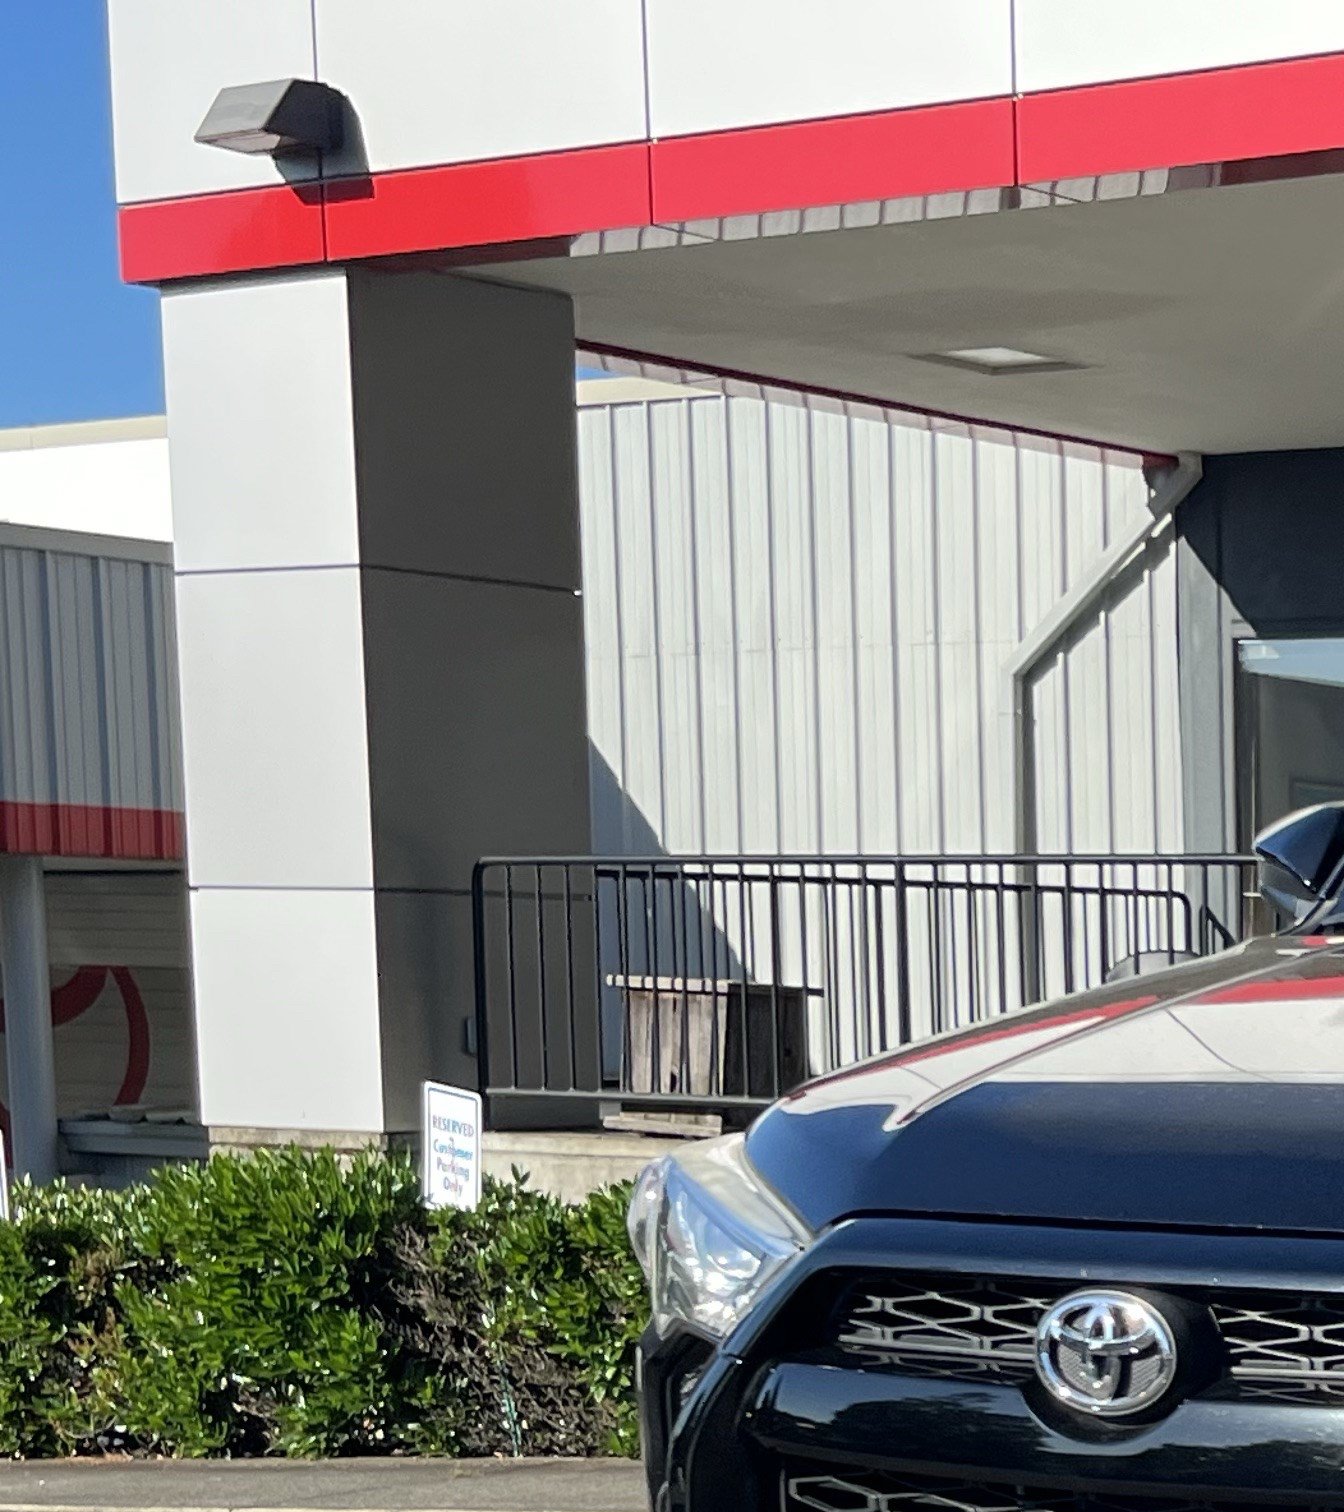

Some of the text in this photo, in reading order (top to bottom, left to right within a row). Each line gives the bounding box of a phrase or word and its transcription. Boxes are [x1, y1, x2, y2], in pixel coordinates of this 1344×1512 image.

[432, 1115, 474, 1138] RESERVED
[433, 1139, 473, 1161] Customer
[437, 1157, 469, 1181] Parking
[443, 1177, 463, 1197] Only
